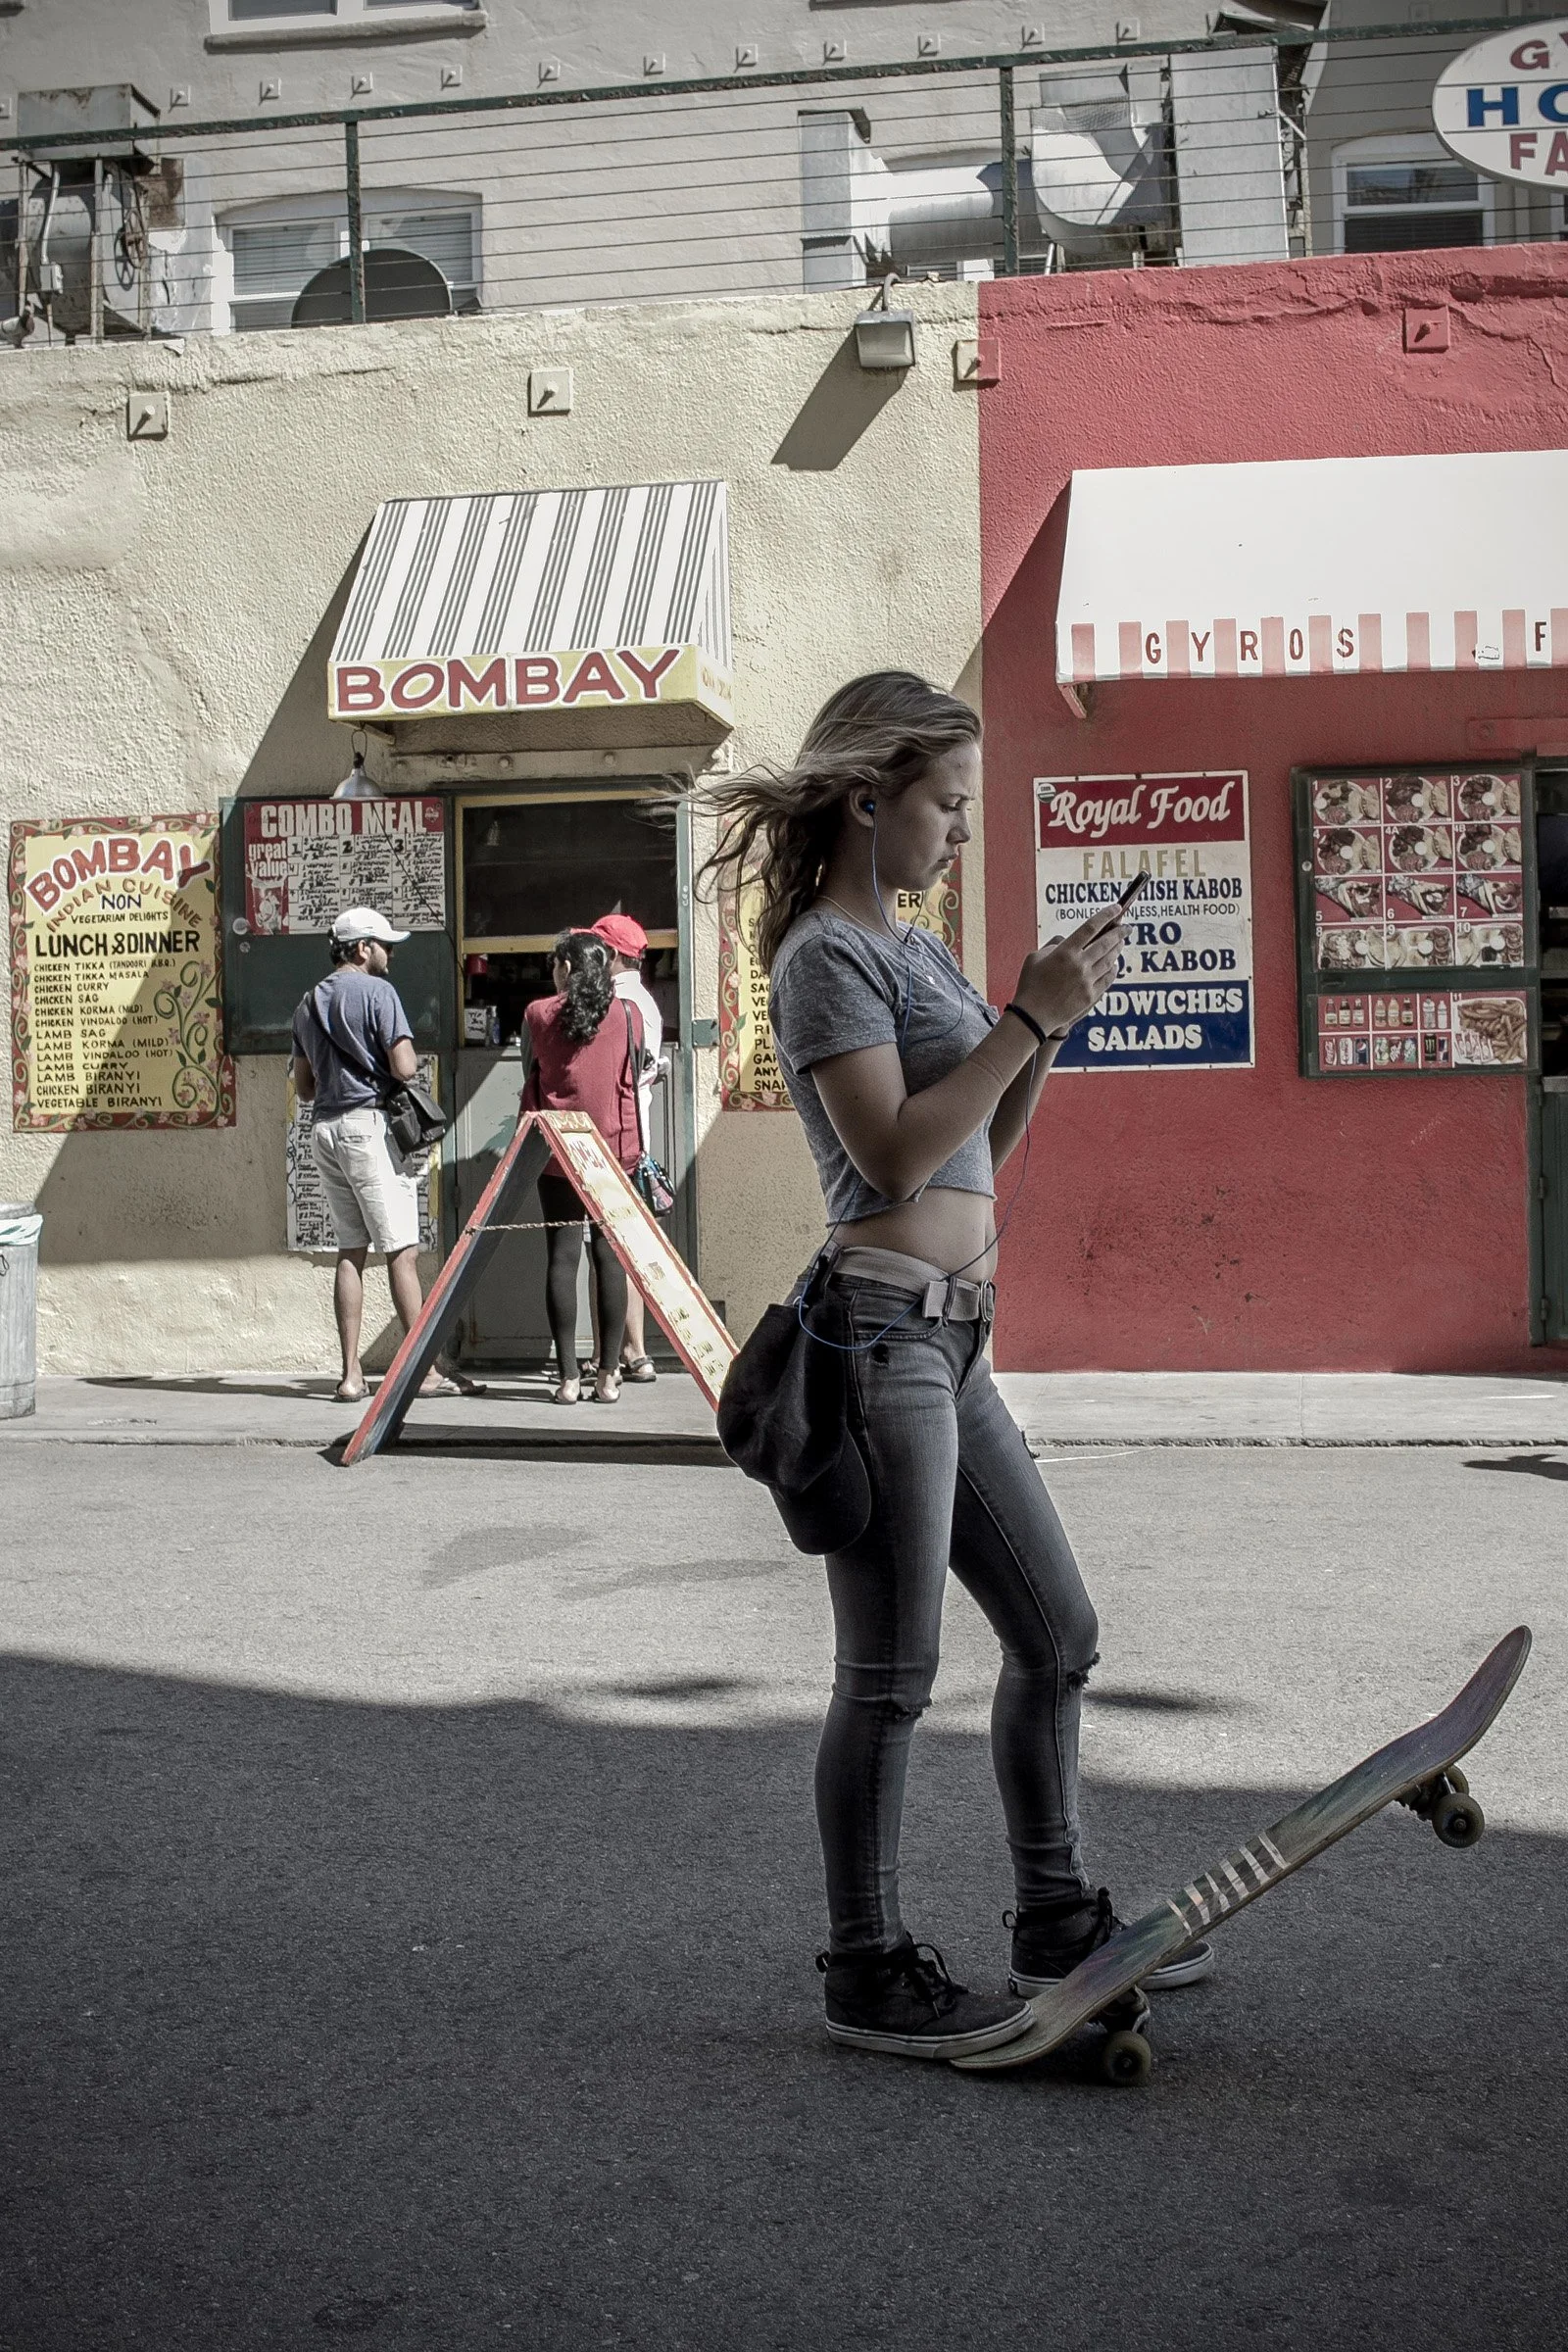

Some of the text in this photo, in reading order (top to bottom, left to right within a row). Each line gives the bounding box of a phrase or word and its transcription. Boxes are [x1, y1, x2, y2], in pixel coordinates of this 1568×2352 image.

[1146, 627, 1354, 664] GYROS
[336, 649, 680, 712] BOMBAY
[1047, 781, 1235, 838] Royal Food
[261, 801, 427, 838] COMBO MEAL
[249, 840, 286, 861] great
[250, 859, 288, 877] value
[1083, 849, 1206, 880] FALAFEL
[26, 837, 212, 912] BOMBAY
[1046, 877, 1242, 905] CHICKEN HISH KABOB
[46, 878, 203, 932] INDIAN CUISINE
[101, 894, 142, 910] NON
[1203, 903, 1240, 915] FOOD)
[71, 910, 169, 924] VEGETARIAN DELIGHTS
[35, 933, 108, 957] LUNCH
[127, 931, 200, 955] DINNER
[34, 963, 70, 972] CHICKEN
[74, 962, 105, 971] TIKKA
[1141, 949, 1236, 973] KABOB
[34, 974, 72, 983] CHICKEN
[109, 971, 149, 980] MASALA
[34, 982, 109, 994] CHICKEN CURRY
[34, 994, 99, 1004] CHICKEN SAG
[1088, 988, 1244, 1017] NDWICHES
[35, 1006, 74, 1016] CHICKEN
[80, 1004, 115, 1015] KORMA
[35, 1018, 74, 1027] CHICKEN
[80, 1016, 127, 1026] VINDALOO
[36, 1029, 106, 1040] LAMB SAG
[1088, 1024, 1202, 1053] SALADS
[36, 1038, 169, 1051] LAMB KORMA (MILD)
[37, 1053, 74, 1062] LAMB
[83, 1050, 139, 1059] VINDALOO
[37, 1062, 74, 1071] LAMB
[37, 1071, 140, 1083] LAMB BIRANYI
[36, 1083, 140, 1096] CHICKEN BIRANYI
[37, 1097, 162, 1108] VEGETABLE BIRANYI
